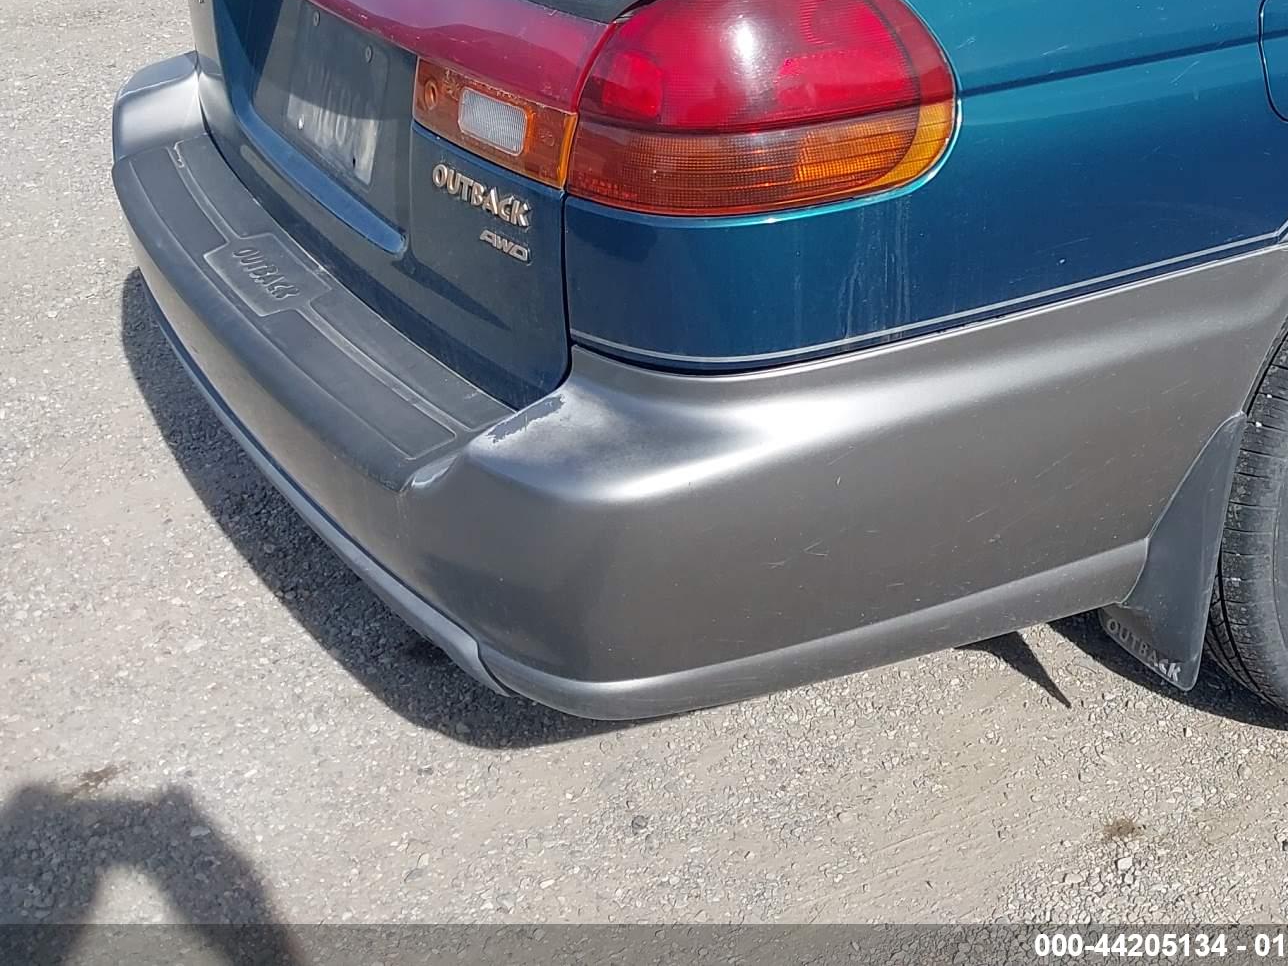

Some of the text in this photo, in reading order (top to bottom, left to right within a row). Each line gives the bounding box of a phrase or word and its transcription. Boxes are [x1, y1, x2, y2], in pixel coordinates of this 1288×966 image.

[432, 164, 531, 227] OUTBACK
[232, 248, 300, 300] OUTBACK
[480, 229, 529, 262] AWD
[1106, 618, 1182, 682] OUTBACK
